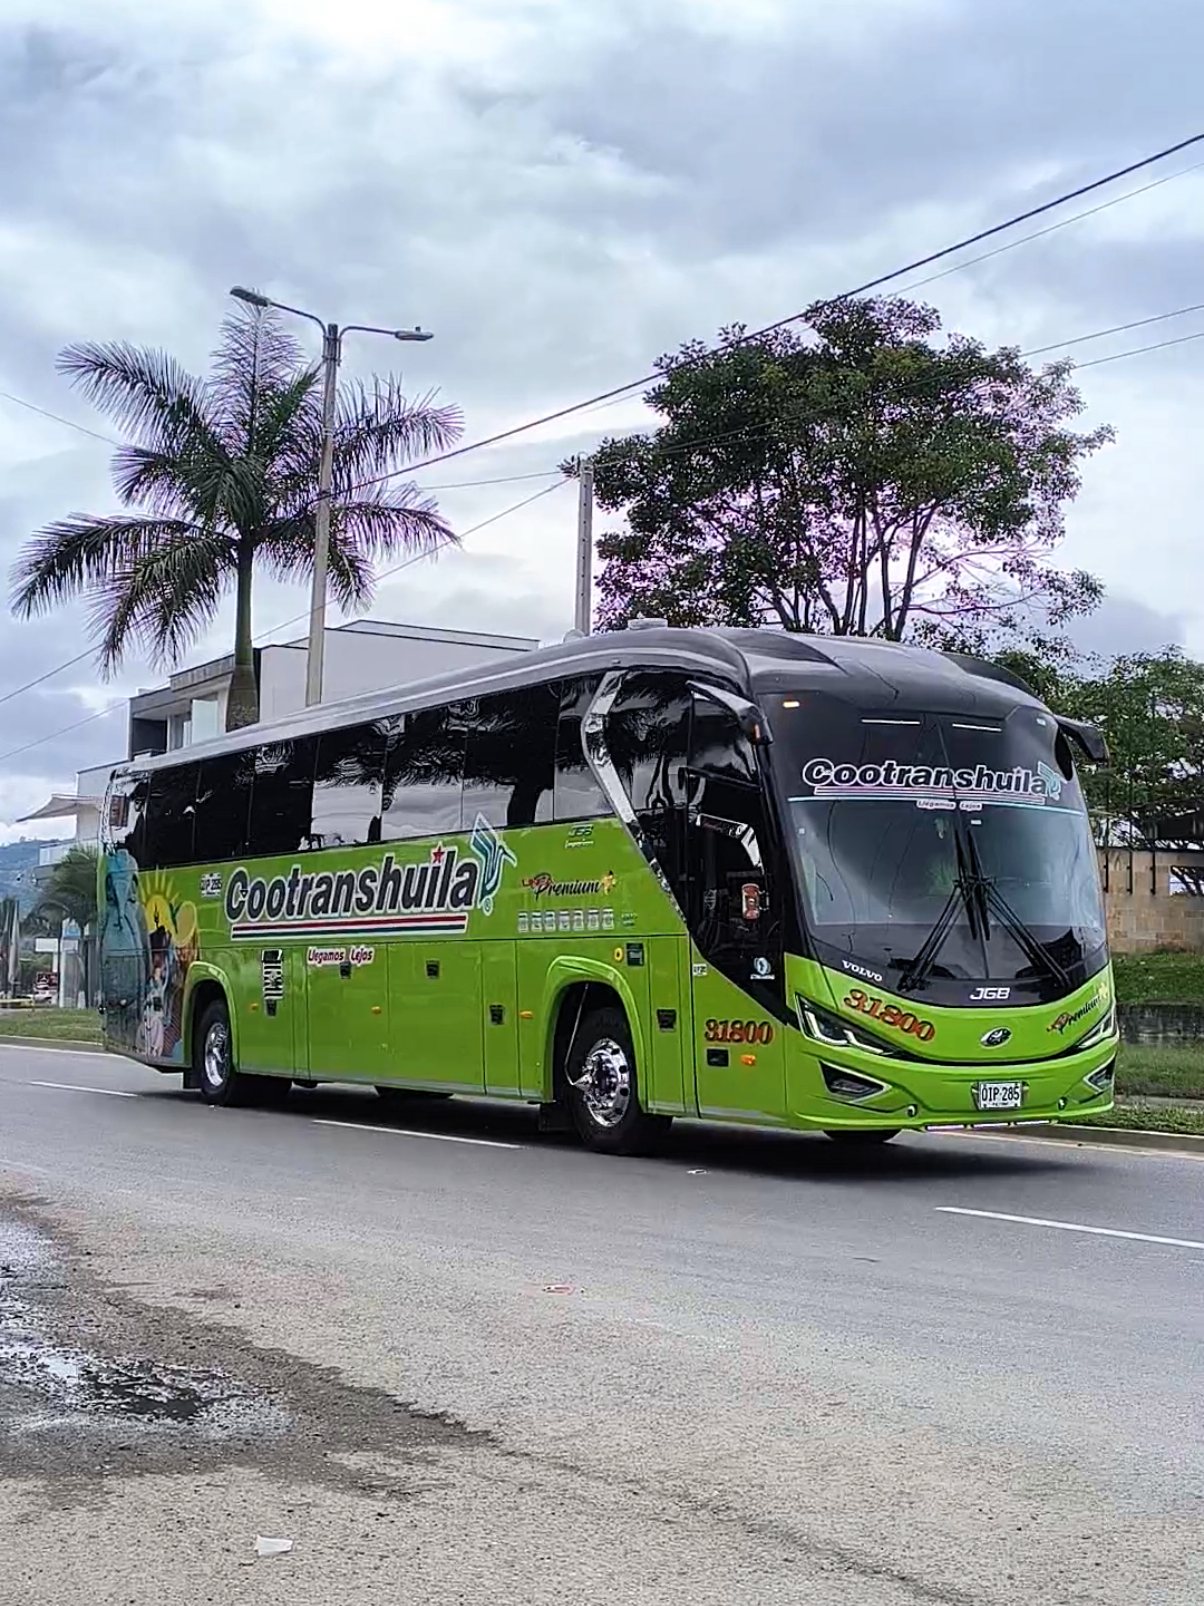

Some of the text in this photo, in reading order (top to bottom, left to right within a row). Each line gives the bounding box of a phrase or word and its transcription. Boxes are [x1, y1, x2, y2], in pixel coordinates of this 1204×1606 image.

[803, 758, 1049, 796] Cootranshuila
[225, 843, 478, 920] Cootranshuila
[534, 872, 601, 901] Premium
[308, 948, 373, 964] Llegamos Lejos
[842, 960, 883, 982] VOLVO
[970, 987, 1011, 1000] JGB
[843, 988, 936, 1042] 31800
[705, 1018, 775, 1045] 31800
